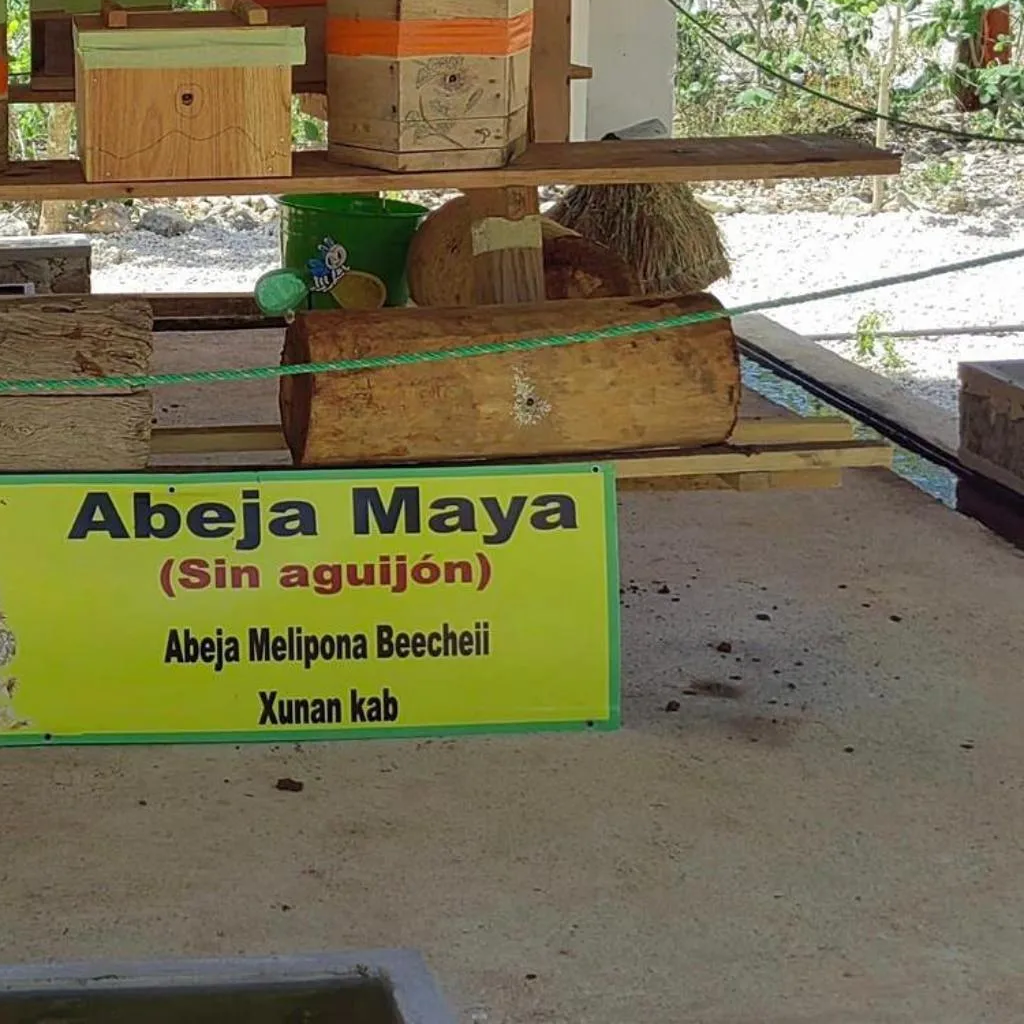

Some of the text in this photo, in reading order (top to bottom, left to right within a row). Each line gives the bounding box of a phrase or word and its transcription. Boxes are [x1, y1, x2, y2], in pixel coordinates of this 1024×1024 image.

[68, 486, 578, 550] Abeja Maya
[159, 552, 492, 597] (Sin aguijón)
[164, 621, 490, 671] Abeja Melipona Beecheii
[258, 688, 399, 725] Xunan kab
